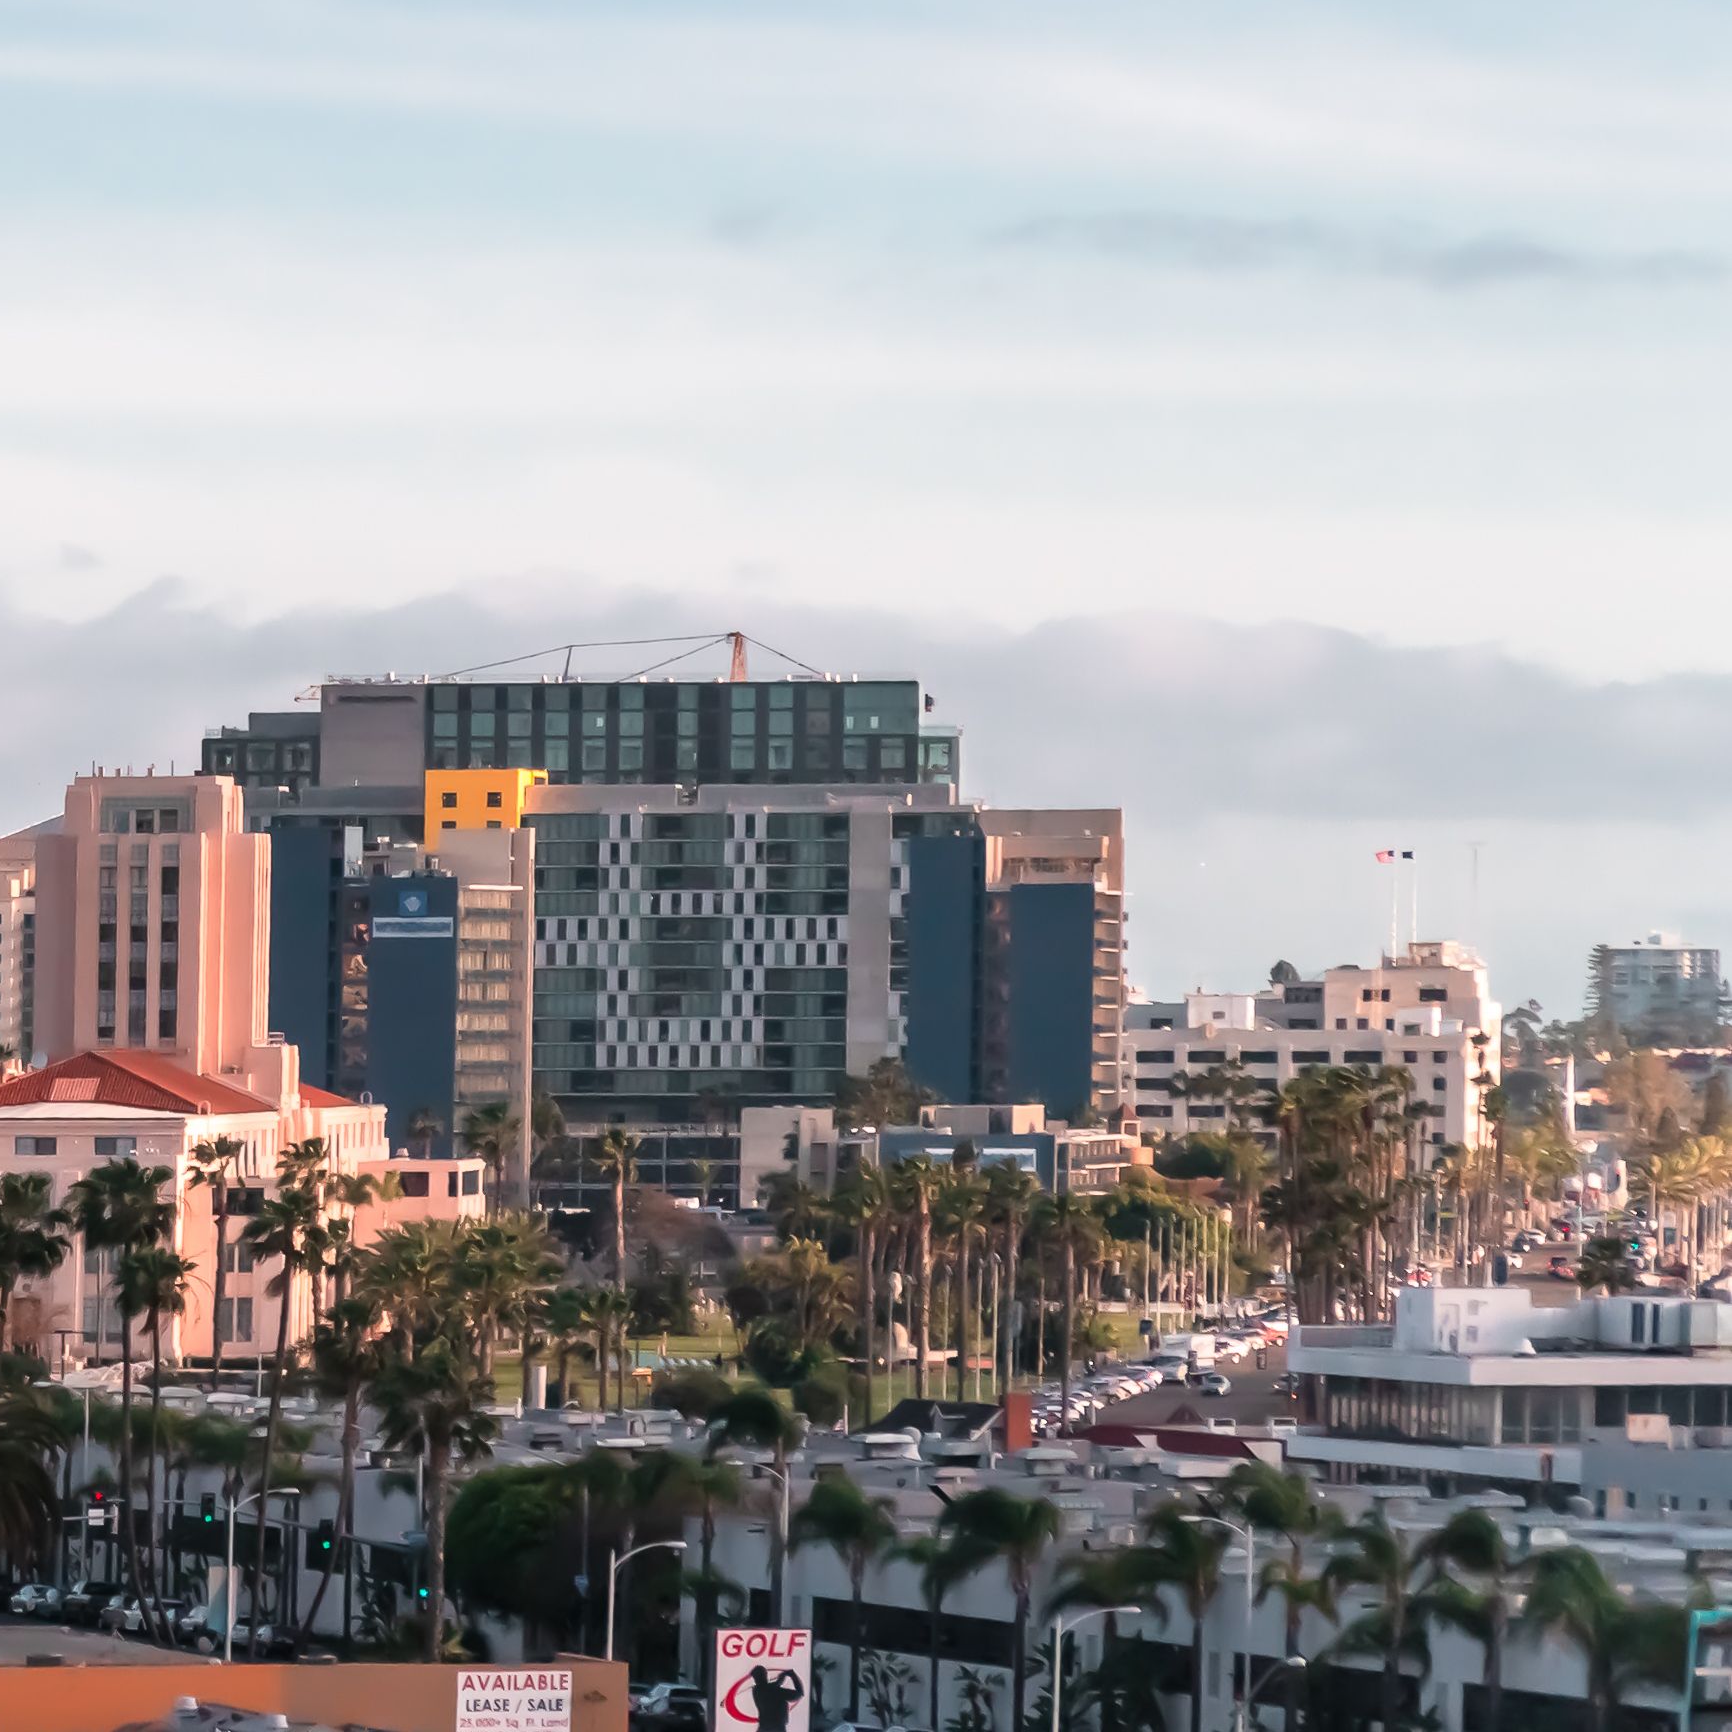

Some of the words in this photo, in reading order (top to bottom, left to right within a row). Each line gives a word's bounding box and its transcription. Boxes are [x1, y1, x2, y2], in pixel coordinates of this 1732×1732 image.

[722, 1632, 807, 1658] GOLF
[462, 1673, 569, 1691] AVAILABLE
[466, 1698, 510, 1713] LEASE
[527, 1698, 563, 1712] SALE
